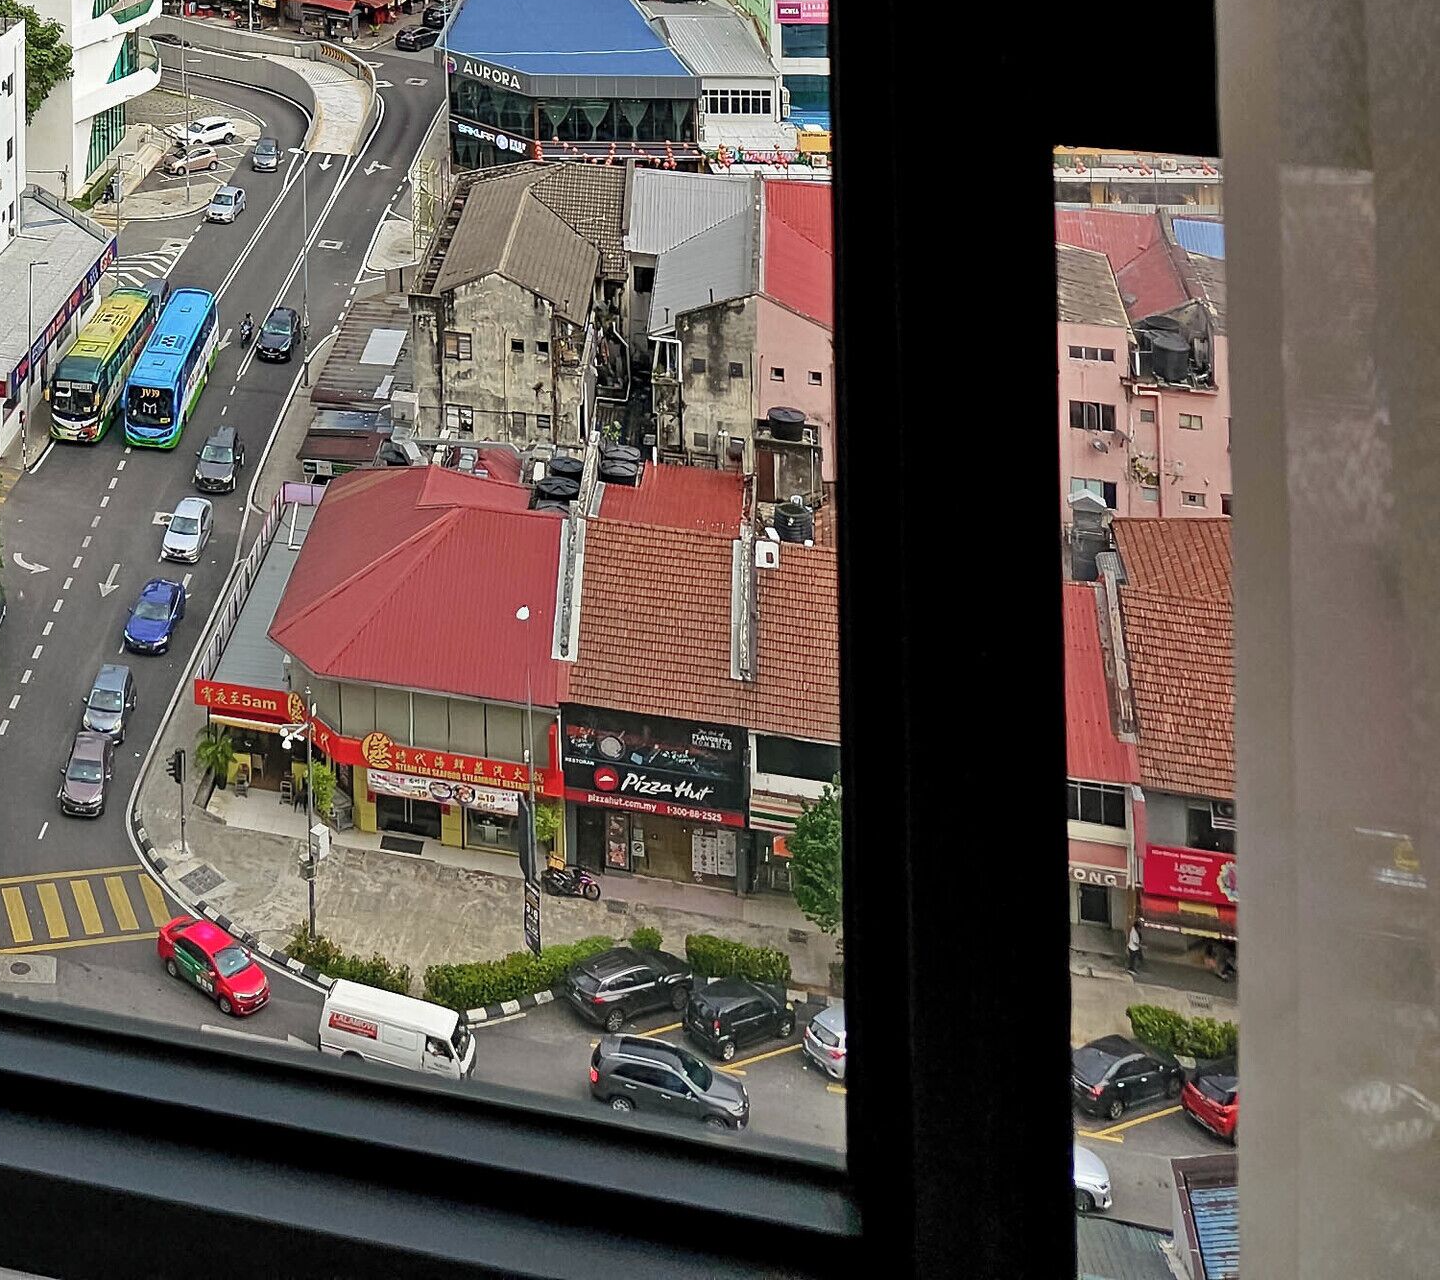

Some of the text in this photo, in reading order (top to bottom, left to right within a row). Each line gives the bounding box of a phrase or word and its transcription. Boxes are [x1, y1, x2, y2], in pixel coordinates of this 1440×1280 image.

[463, 60, 521, 90] AURORA
[457, 123, 496, 143] SAKURA
[395, 762, 418, 774] STEAM
[432, 768, 461, 780] SEAFOOD
[564, 756, 596, 766] RESTORAN
[621, 772, 714, 802] Pizza Hut
[587, 793, 723, 822] pizzahut.com.my 1-300-88-2525
[333, 1012, 377, 1030] LALAMOVE
